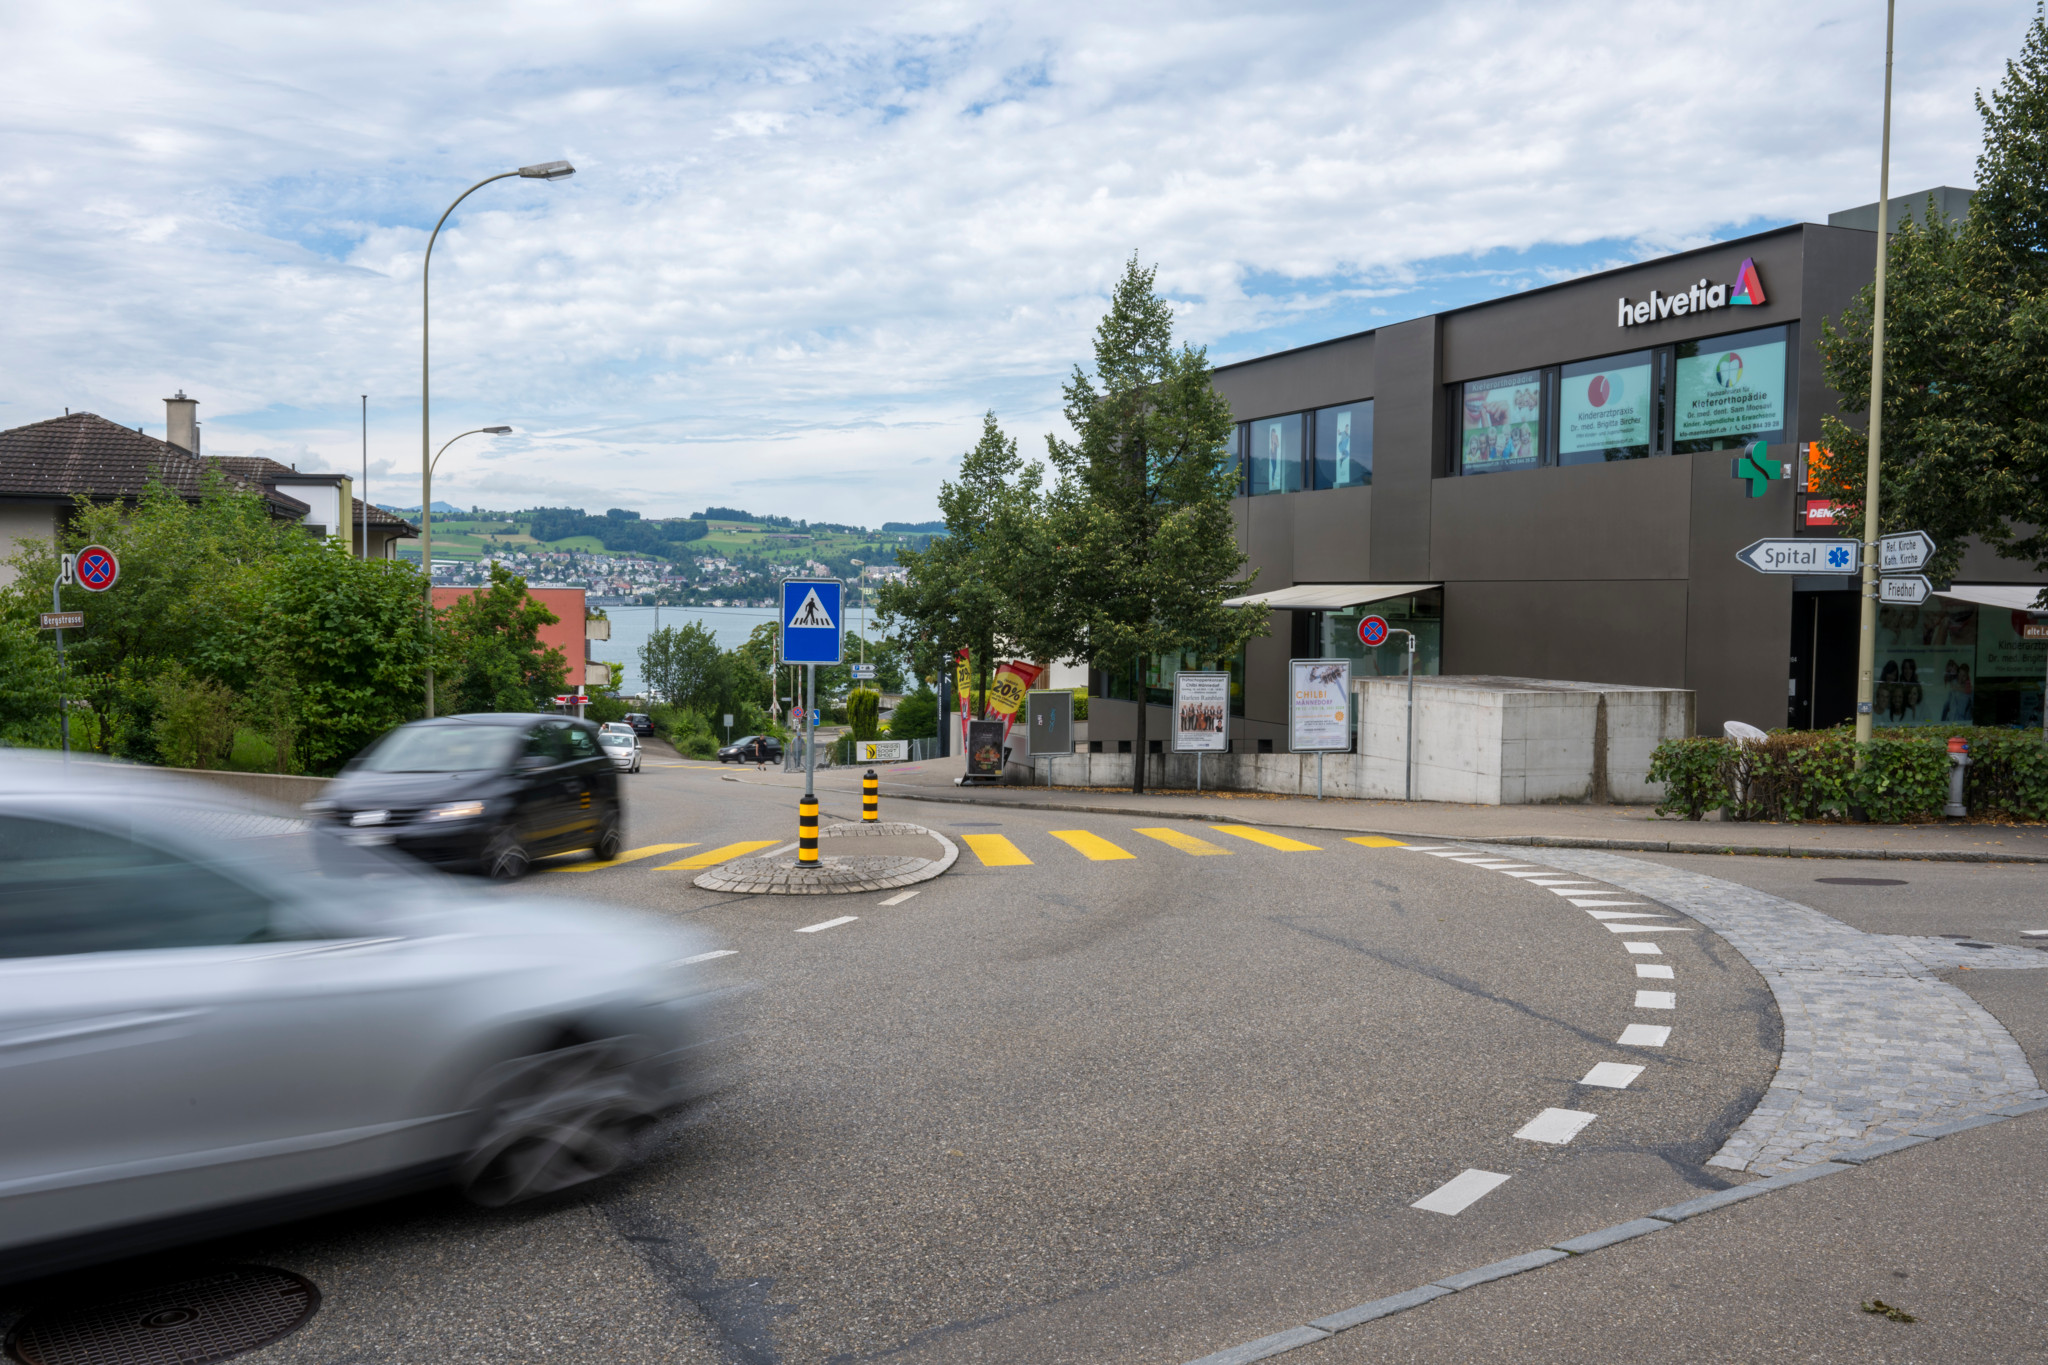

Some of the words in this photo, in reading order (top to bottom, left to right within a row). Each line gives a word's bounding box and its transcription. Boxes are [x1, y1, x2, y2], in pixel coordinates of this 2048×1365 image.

[1618, 278, 1728, 328] helvetia
[1692, 392, 1768, 408] Kieferorthopädie
[1578, 407, 1634, 421] Kinderarztpraxis
[1886, 542, 1897, 553] Ref.
[1898, 539, 1917, 552] Kirche
[1764, 547, 1816, 568] Spital
[1884, 555, 1898, 566] Kath.
[1900, 554, 1918, 565] Kirche
[1888, 582, 1916, 598] Friedhof
[43, 615, 82, 626] Bergstrasse
[993, 680, 1022, 701] 20%
[1296, 690, 1327, 699] CHILBI
